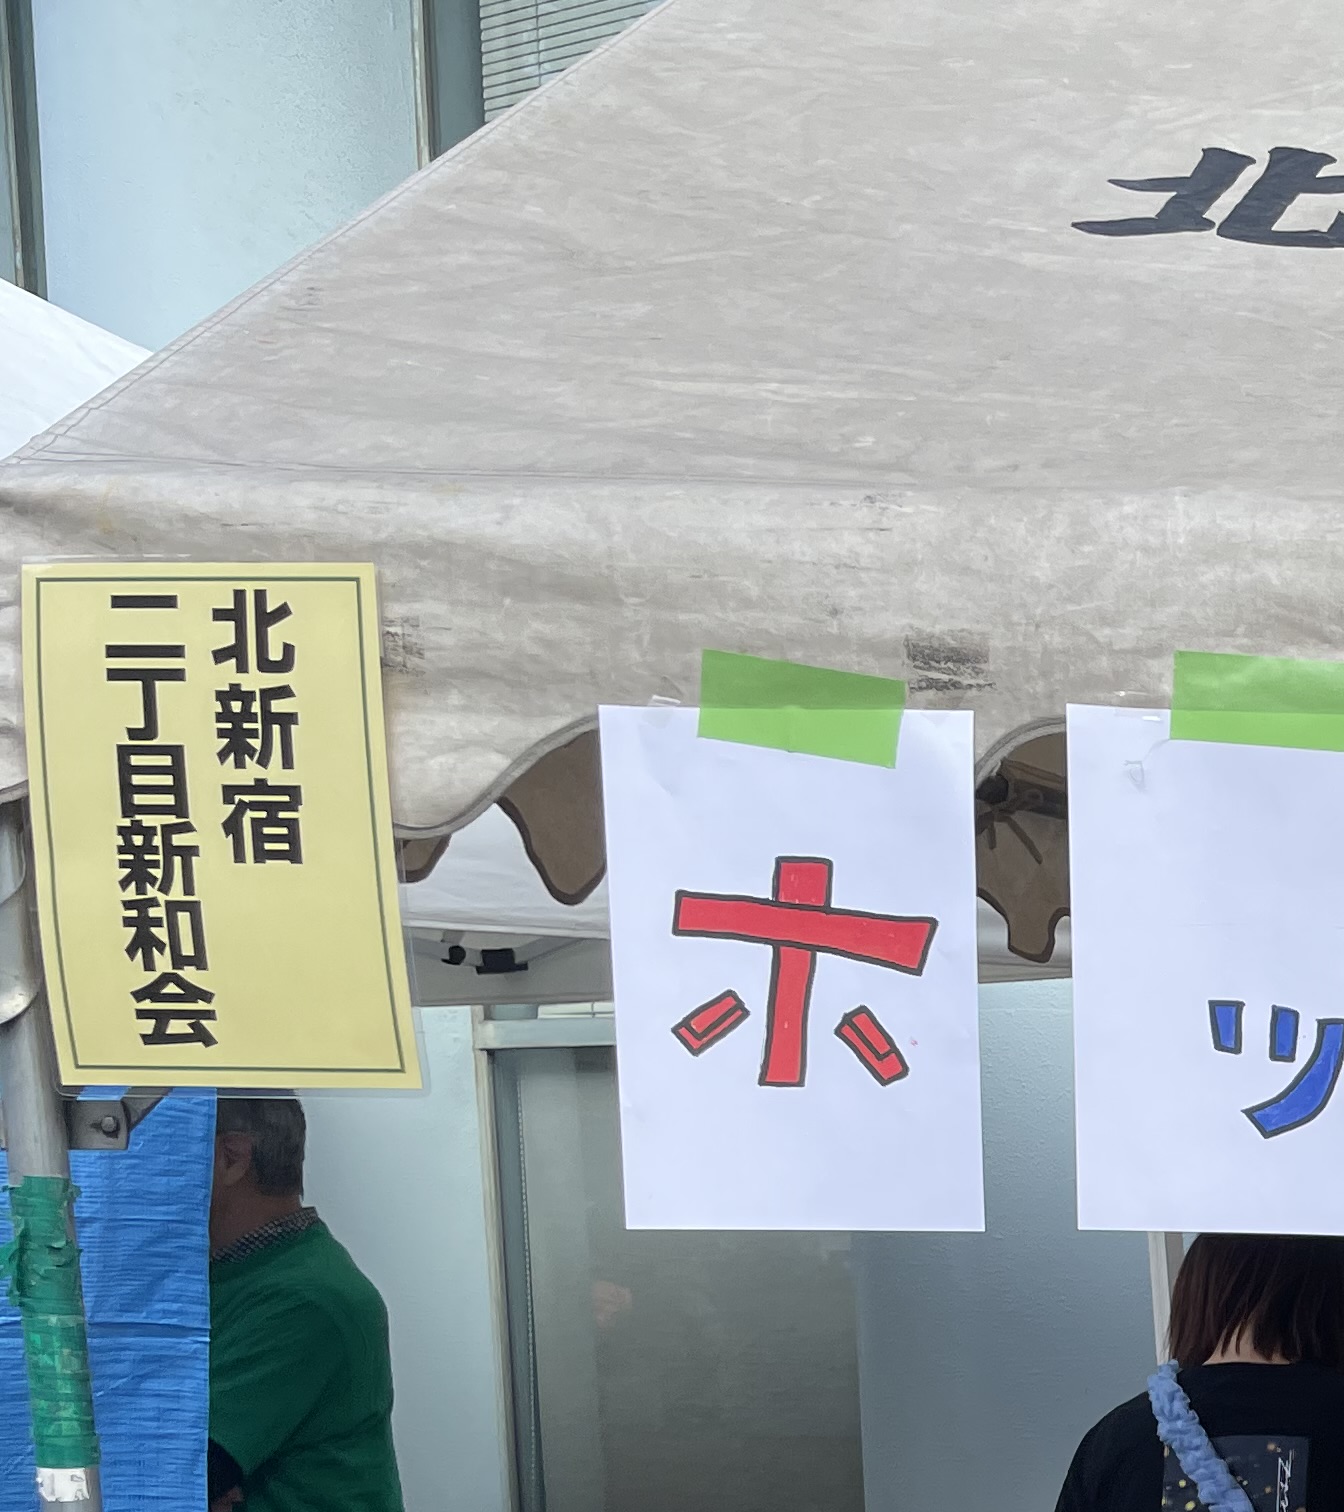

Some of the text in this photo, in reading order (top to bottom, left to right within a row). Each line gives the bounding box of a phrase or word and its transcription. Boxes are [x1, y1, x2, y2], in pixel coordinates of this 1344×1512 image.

[104, 593, 219, 1049] 二丁目新和会
[211, 587, 304, 865] 北新宿
